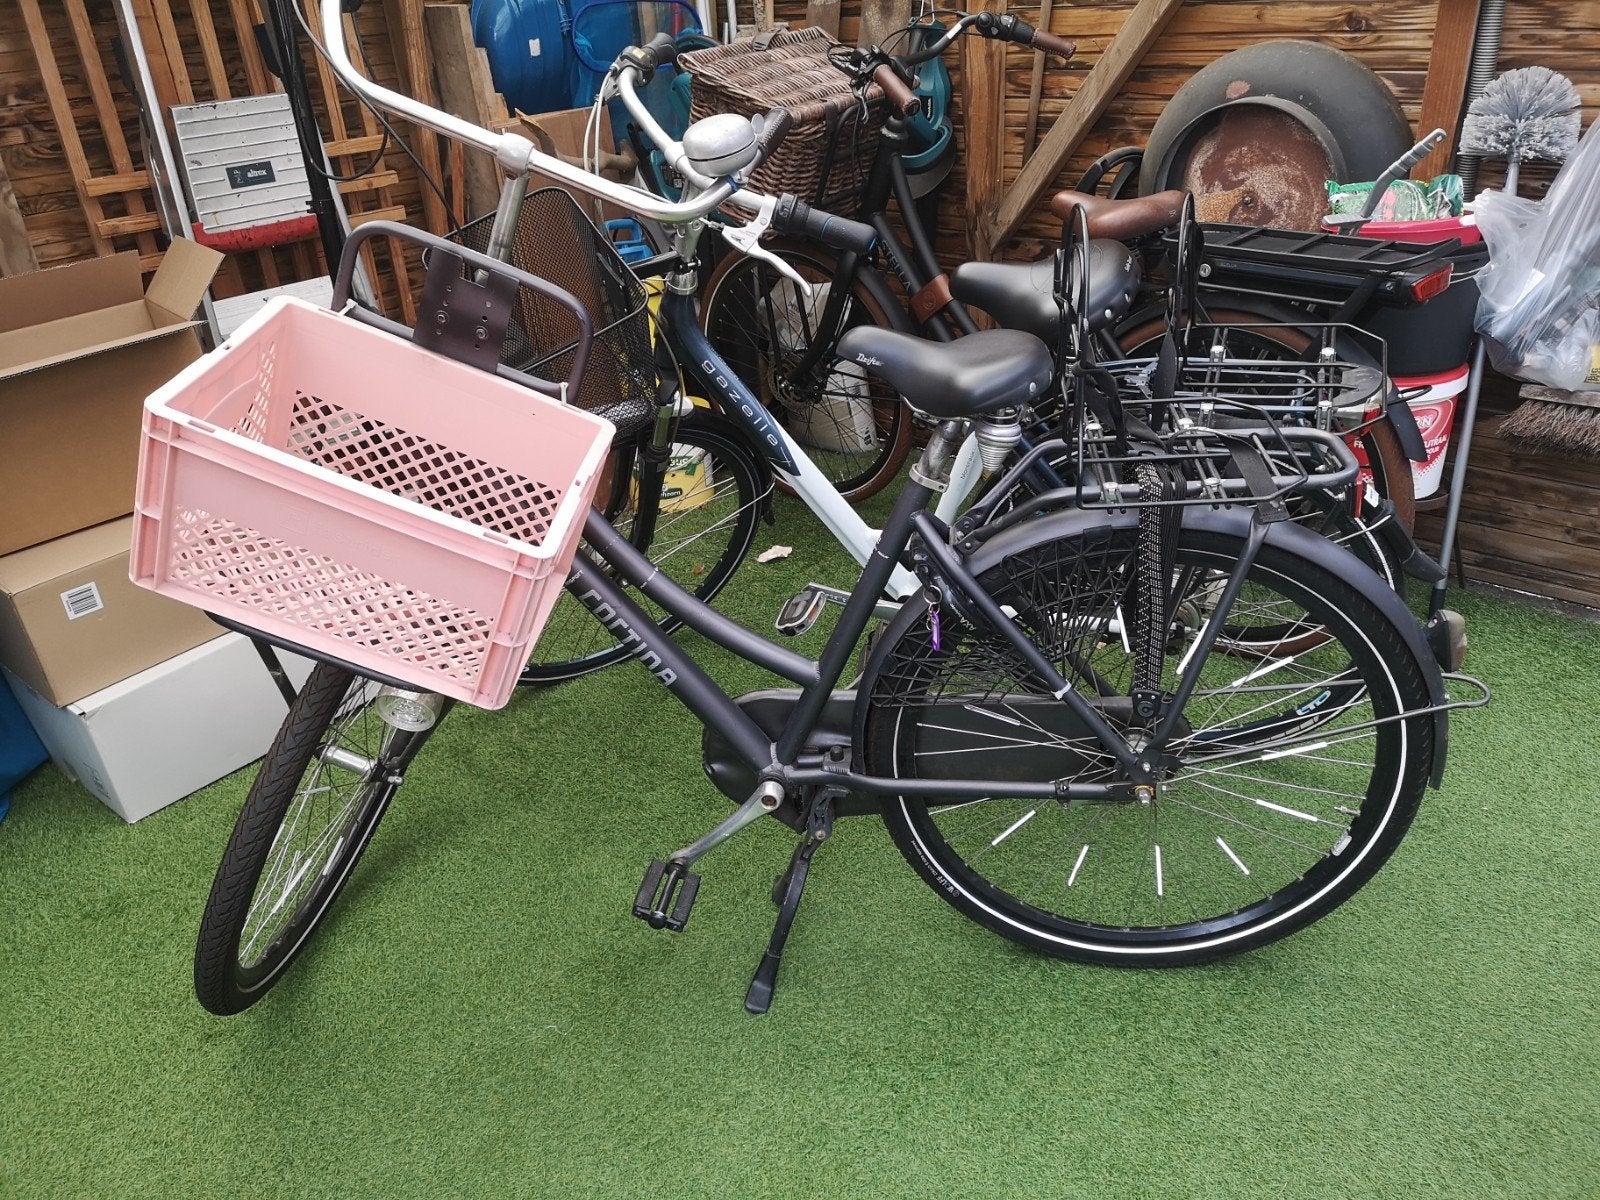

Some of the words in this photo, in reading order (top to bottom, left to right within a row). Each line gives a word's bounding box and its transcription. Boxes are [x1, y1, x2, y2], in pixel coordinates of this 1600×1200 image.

[881, 239, 912, 292] STELLA
[701, 359, 779, 447] gazelle
[1423, 433, 1448, 449] UTRAAL
[579, 588, 678, 687] CORTINA
[960, 616, 977, 631] AXA
